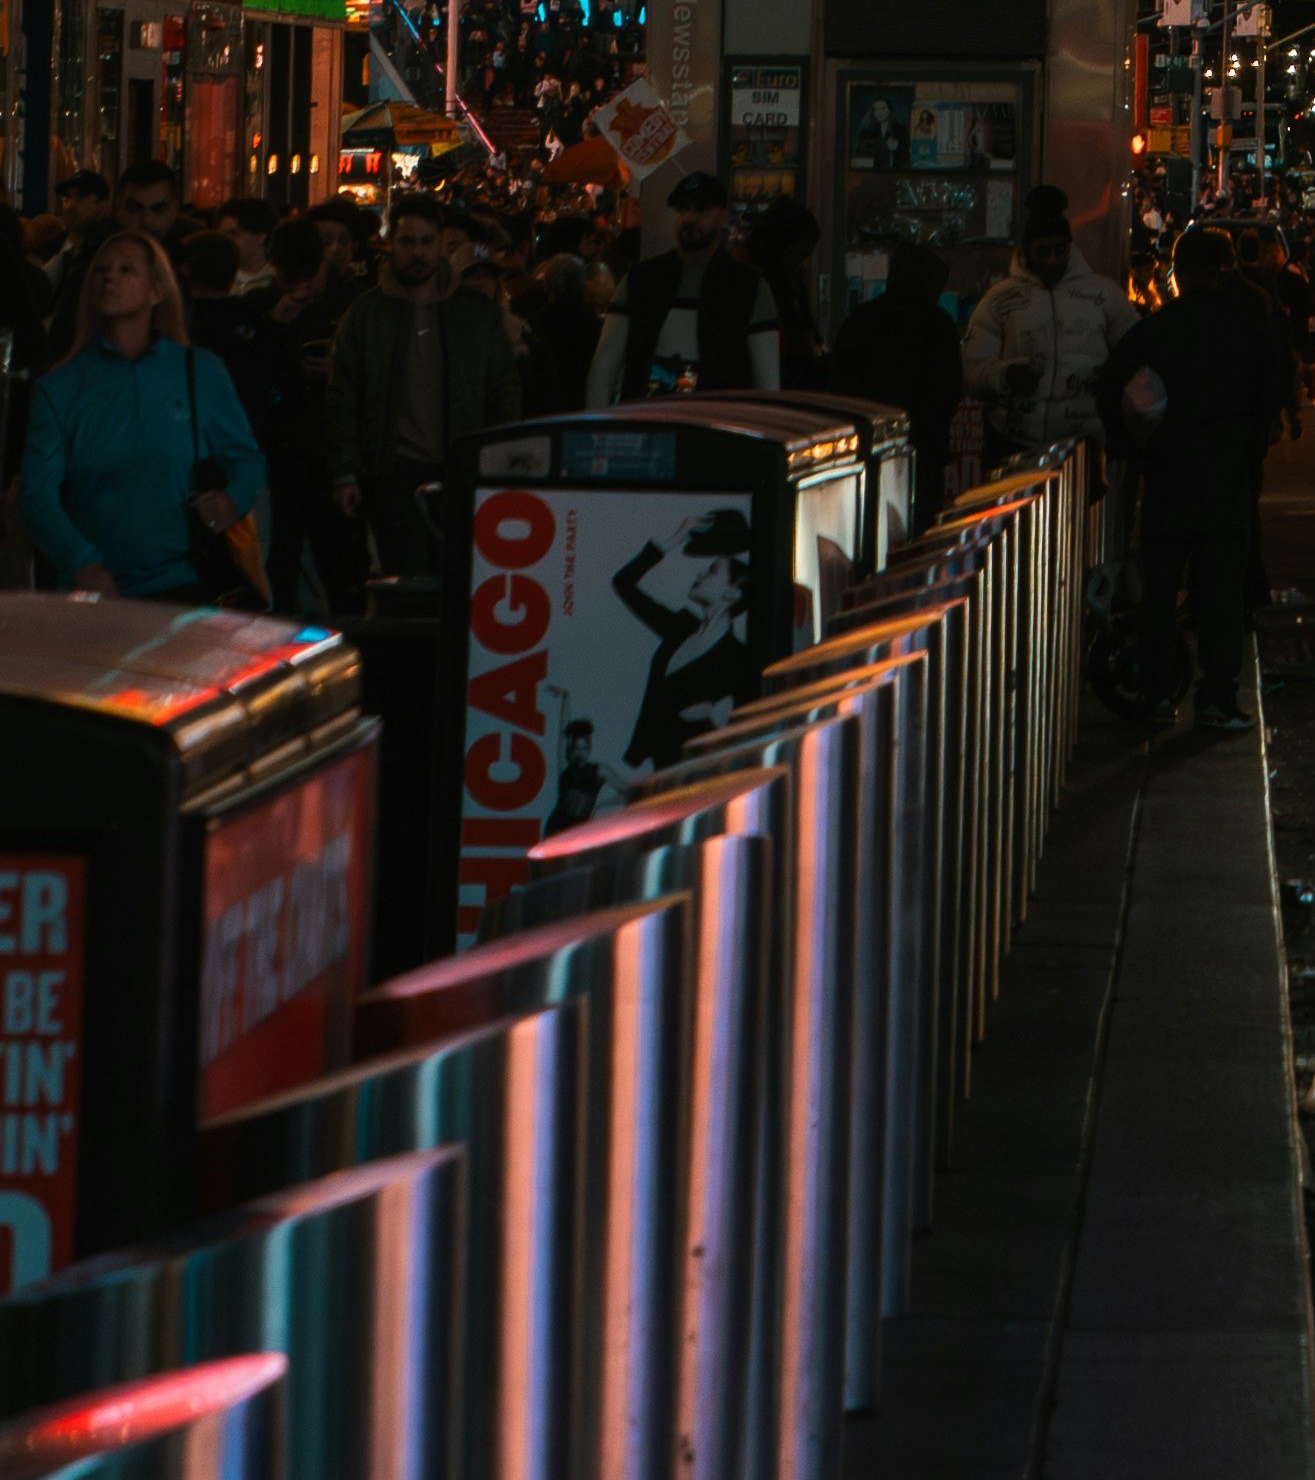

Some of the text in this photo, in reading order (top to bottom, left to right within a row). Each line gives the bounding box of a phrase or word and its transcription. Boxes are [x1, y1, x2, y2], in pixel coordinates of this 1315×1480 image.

[752, 91, 780, 105] SIM
[742, 111, 788, 126] CARD
[2, 970, 65, 1035] BE
